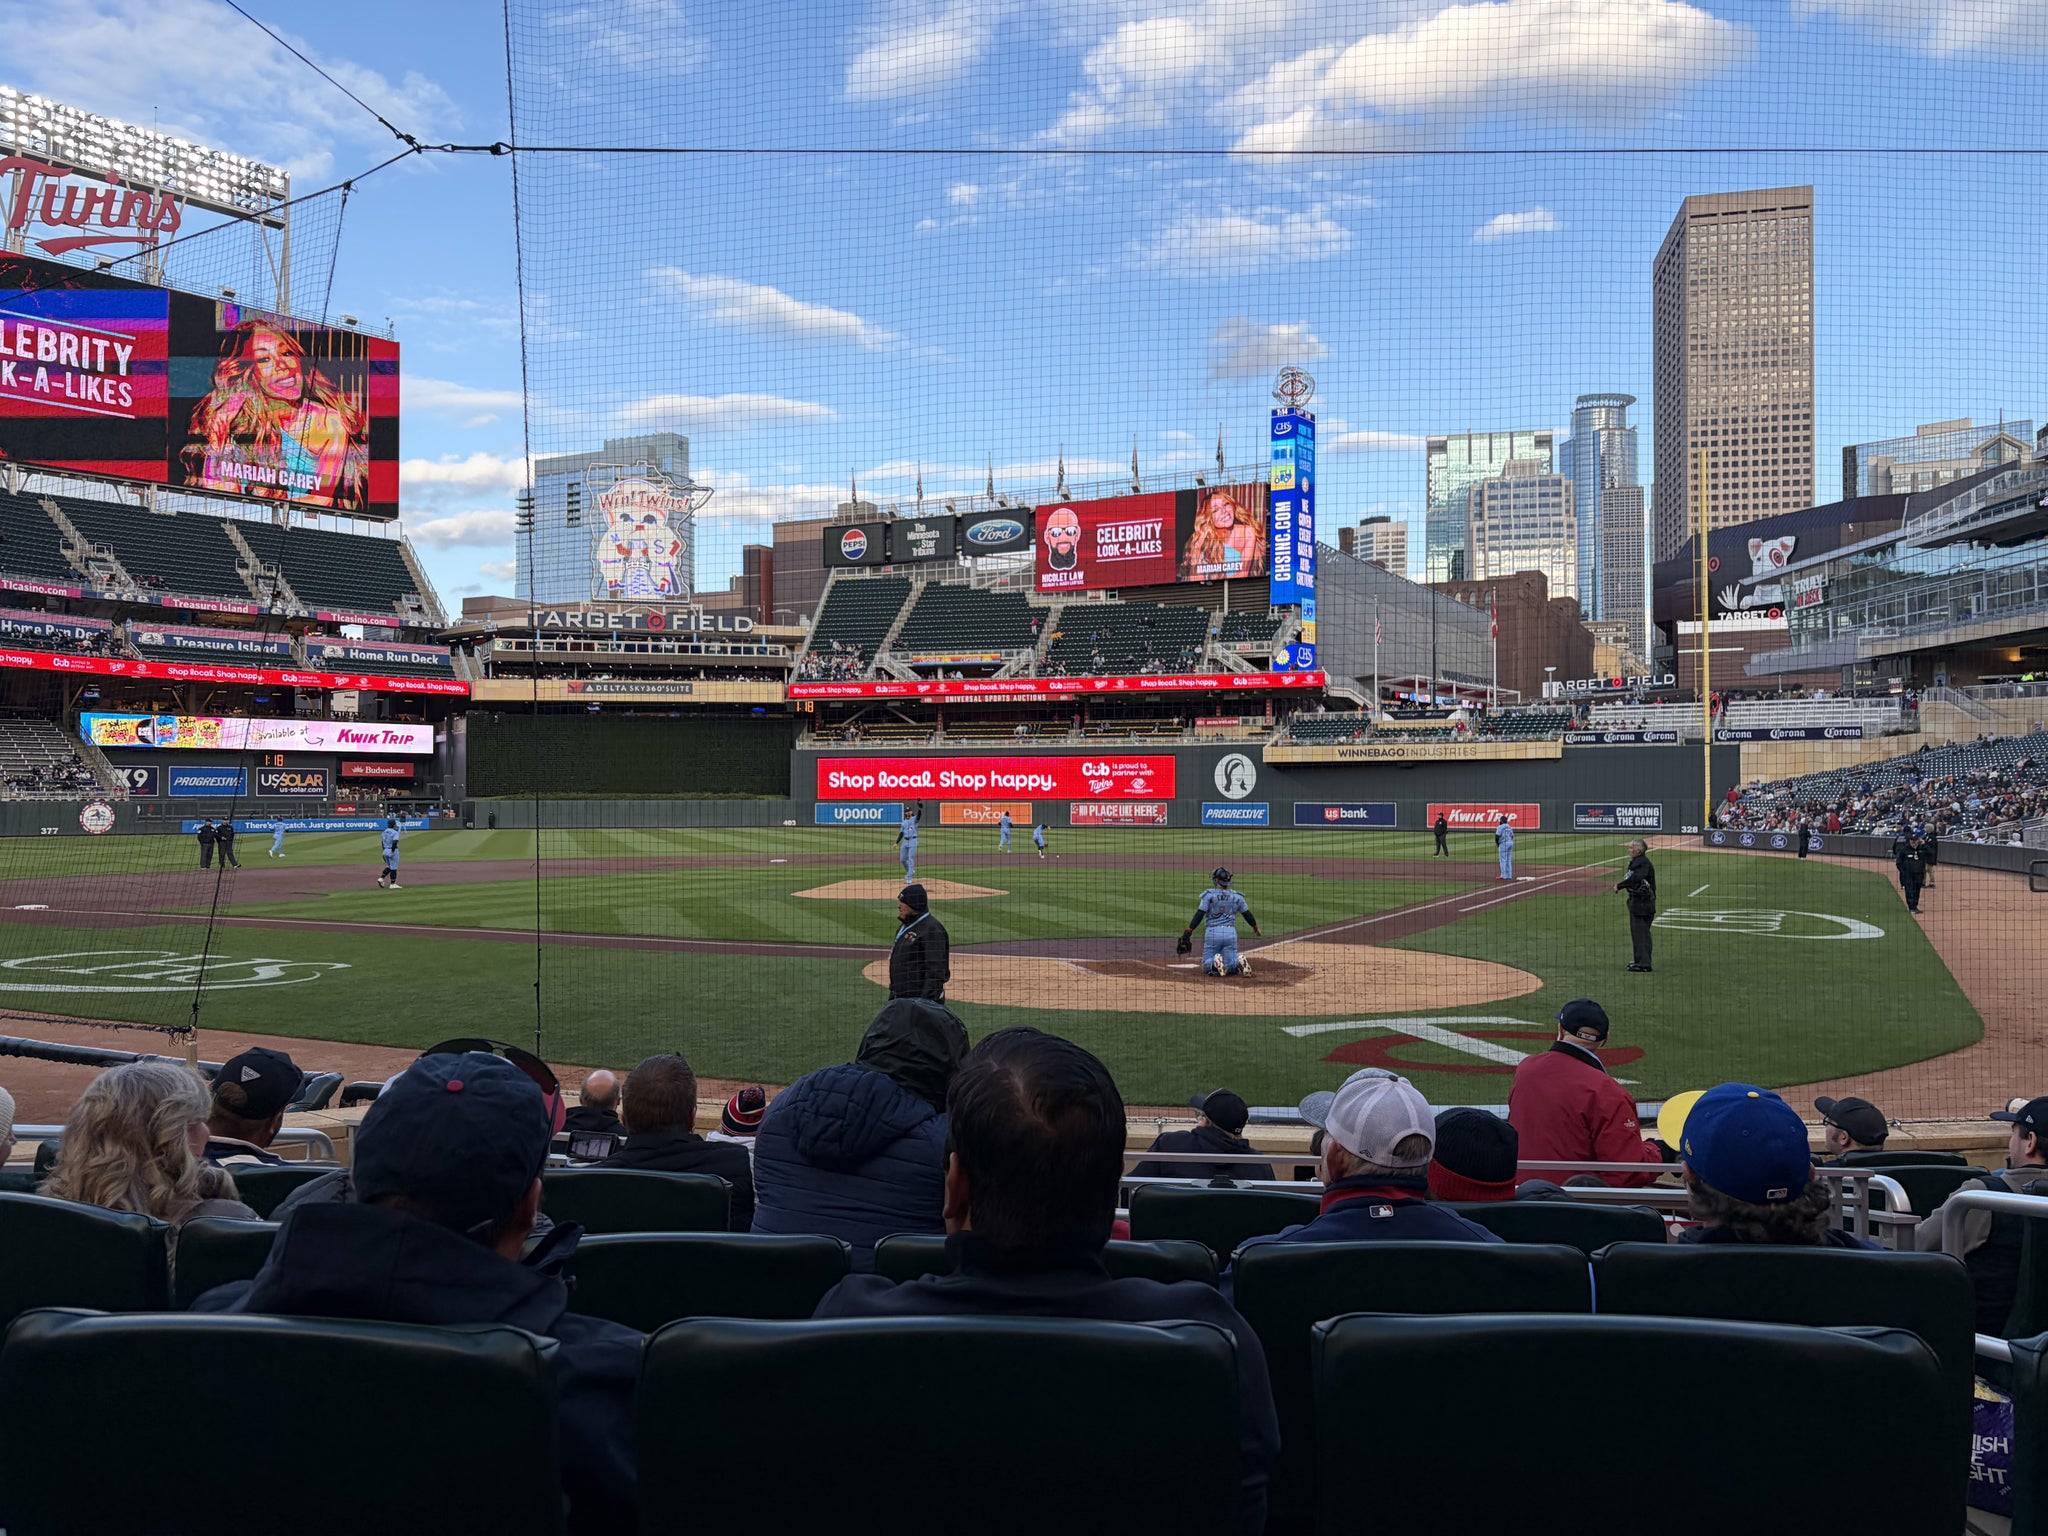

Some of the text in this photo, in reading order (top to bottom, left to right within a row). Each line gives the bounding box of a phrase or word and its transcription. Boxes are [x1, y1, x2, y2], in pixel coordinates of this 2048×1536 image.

[1, 157, 182, 234] Twins
[1, 360, 133, 407] K-A-LIKES
[220, 461, 322, 492] MARIAH CAREY
[638, 490, 689, 510] Twins!
[914, 523, 926, 532] The
[977, 525, 1011, 541] Ford
[1096, 522, 1162, 544] CELEBRITY
[907, 530, 939, 541] Minnesota
[1275, 501, 1291, 582] CHSINC.COM
[843, 540, 866, 549] PEPSI
[1096, 540, 1162, 558] LOOK-A-LIKES
[912, 547, 935, 557] Tribune
[1197, 561, 1243, 573] MARIAH CAREY
[1042, 571, 1084, 582] NICOLET LAW
[173, 599, 249, 614] Treasure Island
[528, 610, 753, 633] TARGET FIELD
[1718, 610, 1766, 621] TARGET
[350, 649, 438, 664] Home Run Deck
[168, 667, 188, 680] Shop
[216, 671, 237, 680] Shop
[237, 672, 265, 681] happy.
[1627, 674, 1675, 686] FIELD
[388, 680, 405, 690] Shop
[427, 683, 444, 692] Shop
[596, 684, 627, 692] DELTA
[945, 695, 982, 703] UNIVERSAL
[984, 694, 1010, 702] SPORTS
[258, 725, 309, 741] available at
[1565, 731, 1675, 743] Corona Corona Corona
[1717, 727, 1861, 740] Corona Corona Corona
[1338, 747, 1477, 758] WINNEBAGO INDUSTRIES
[365, 766, 405, 774] Budweiser
[1082, 762, 1110, 776] Cub
[1119, 762, 1138, 770] proud
[1112, 769, 1137, 777] partner
[829, 770, 1057, 791] Shop local. Shop happy.
[834, 807, 884, 822] uponor
[1089, 804, 1118, 816] PLACE
[1119, 804, 1133, 816] LIKE
[1134, 804, 1158, 816] HERE
[1205, 809, 1266, 820] PROGRESSIVE
[1325, 807, 1367, 819] us bank
[1616, 807, 1659, 817] CHANGING
[325, 822, 345, 830] great
[346, 822, 379, 830] coverage.
[1617, 816, 1658, 826] THE GAME
[40, 827, 59, 835] 377
